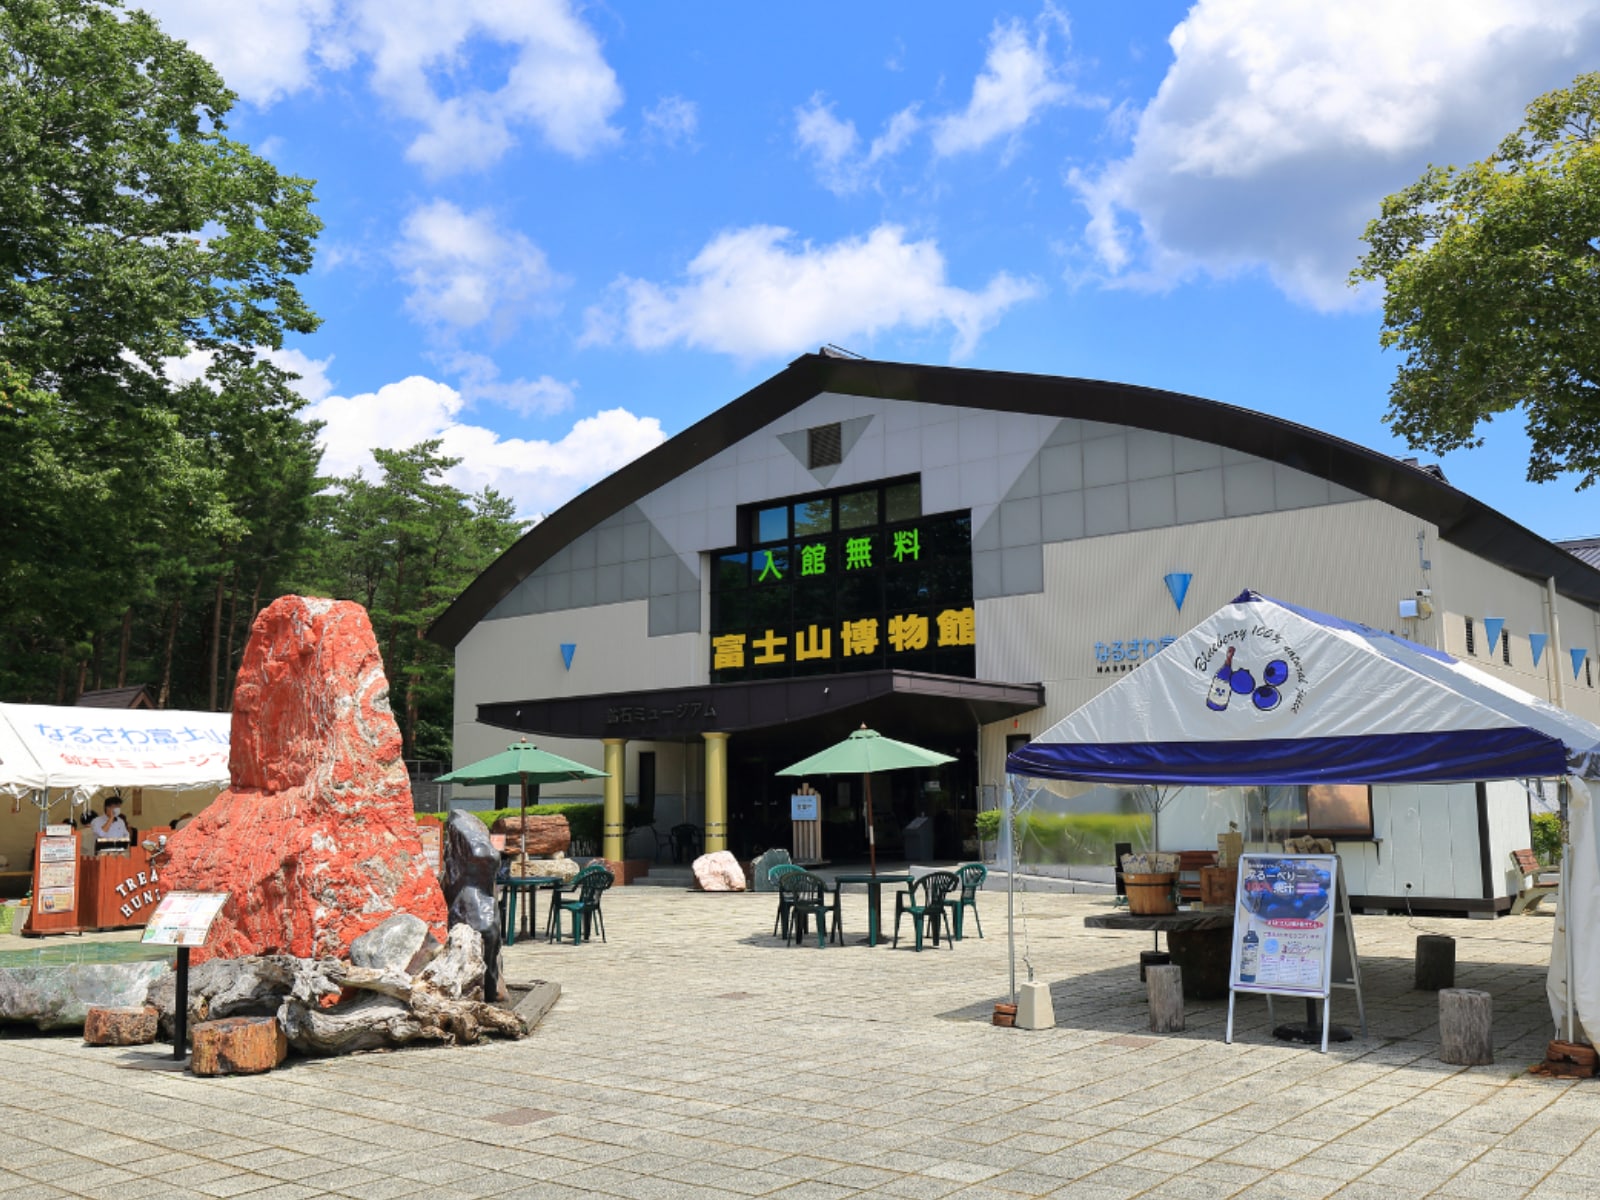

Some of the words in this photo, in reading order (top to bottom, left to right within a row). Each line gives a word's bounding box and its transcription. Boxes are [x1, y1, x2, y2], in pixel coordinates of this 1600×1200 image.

[758, 528, 920, 582] 入館無料
[712, 607, 976, 670] 富士山博物館
[1195, 628, 1247, 672] Blueberry
